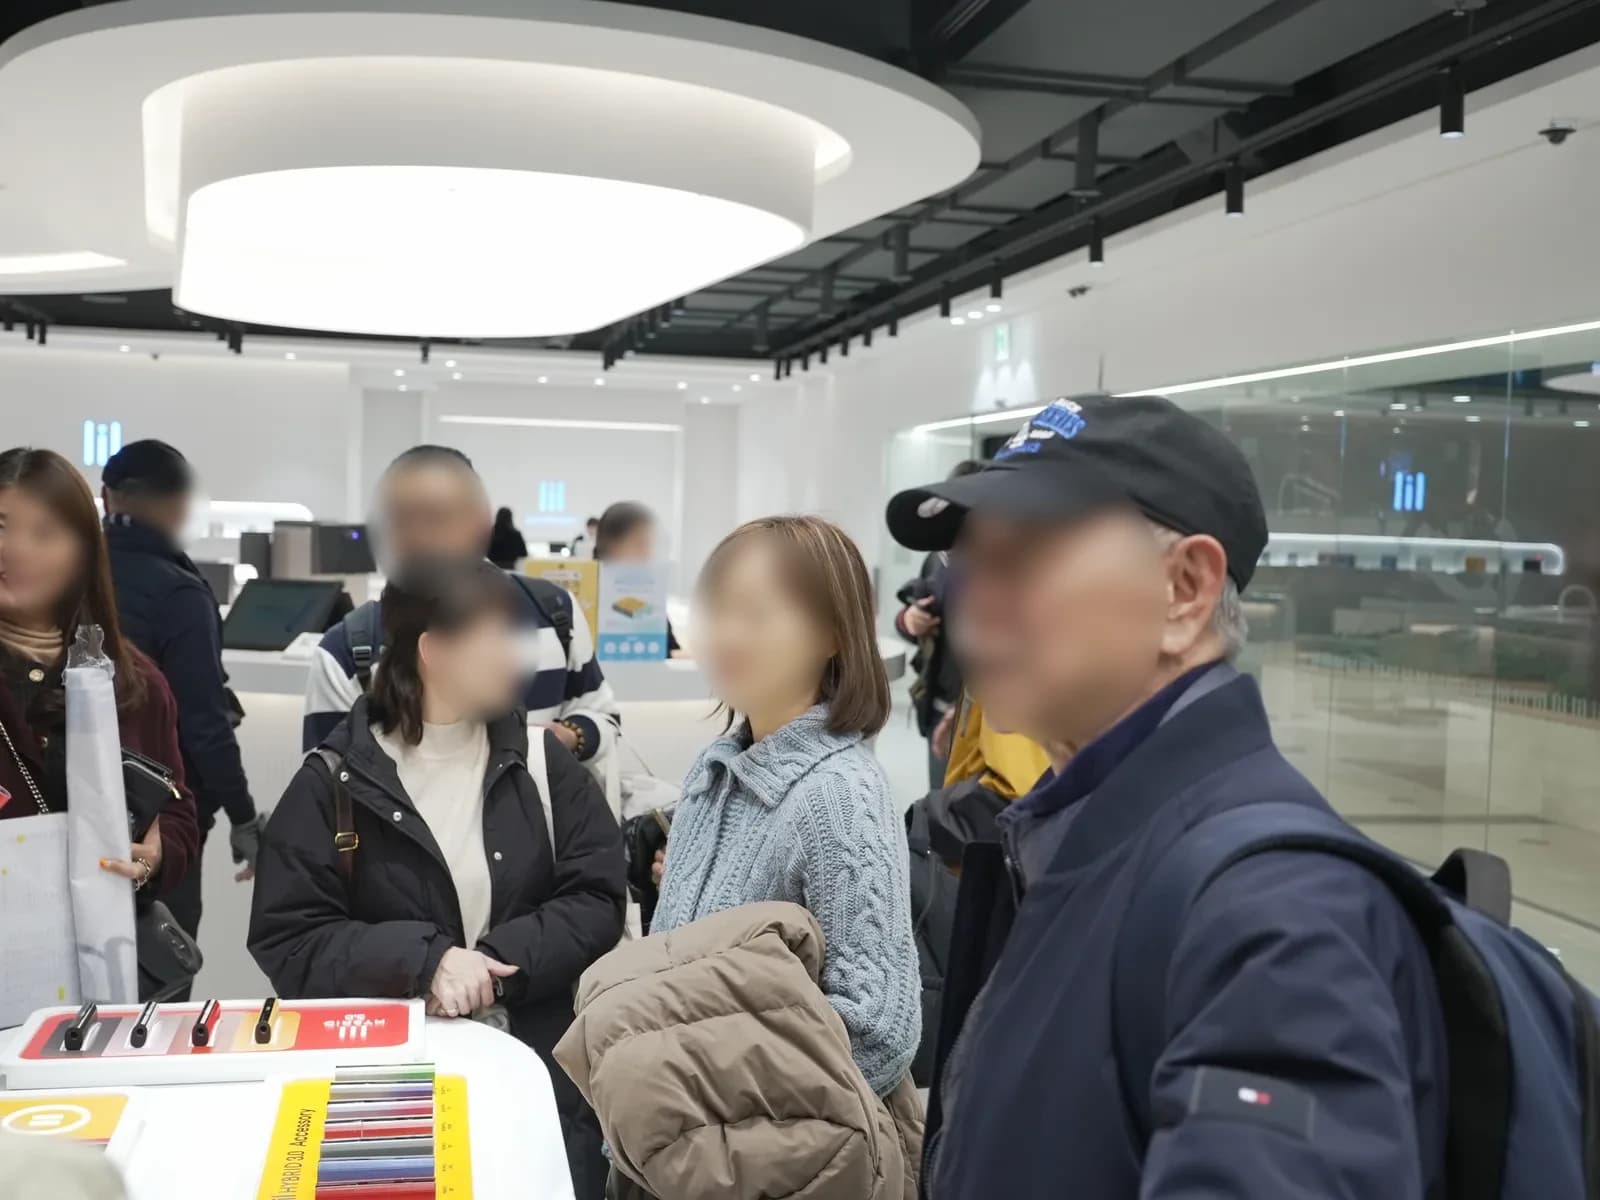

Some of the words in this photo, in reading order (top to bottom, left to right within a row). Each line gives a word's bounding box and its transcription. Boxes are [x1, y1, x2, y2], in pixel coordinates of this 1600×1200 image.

[83, 419, 122, 467] lil
[1393, 470, 1426, 512] lil
[289, 1108, 316, 1147] Accessory
[279, 1162, 303, 1194] HYBRID
